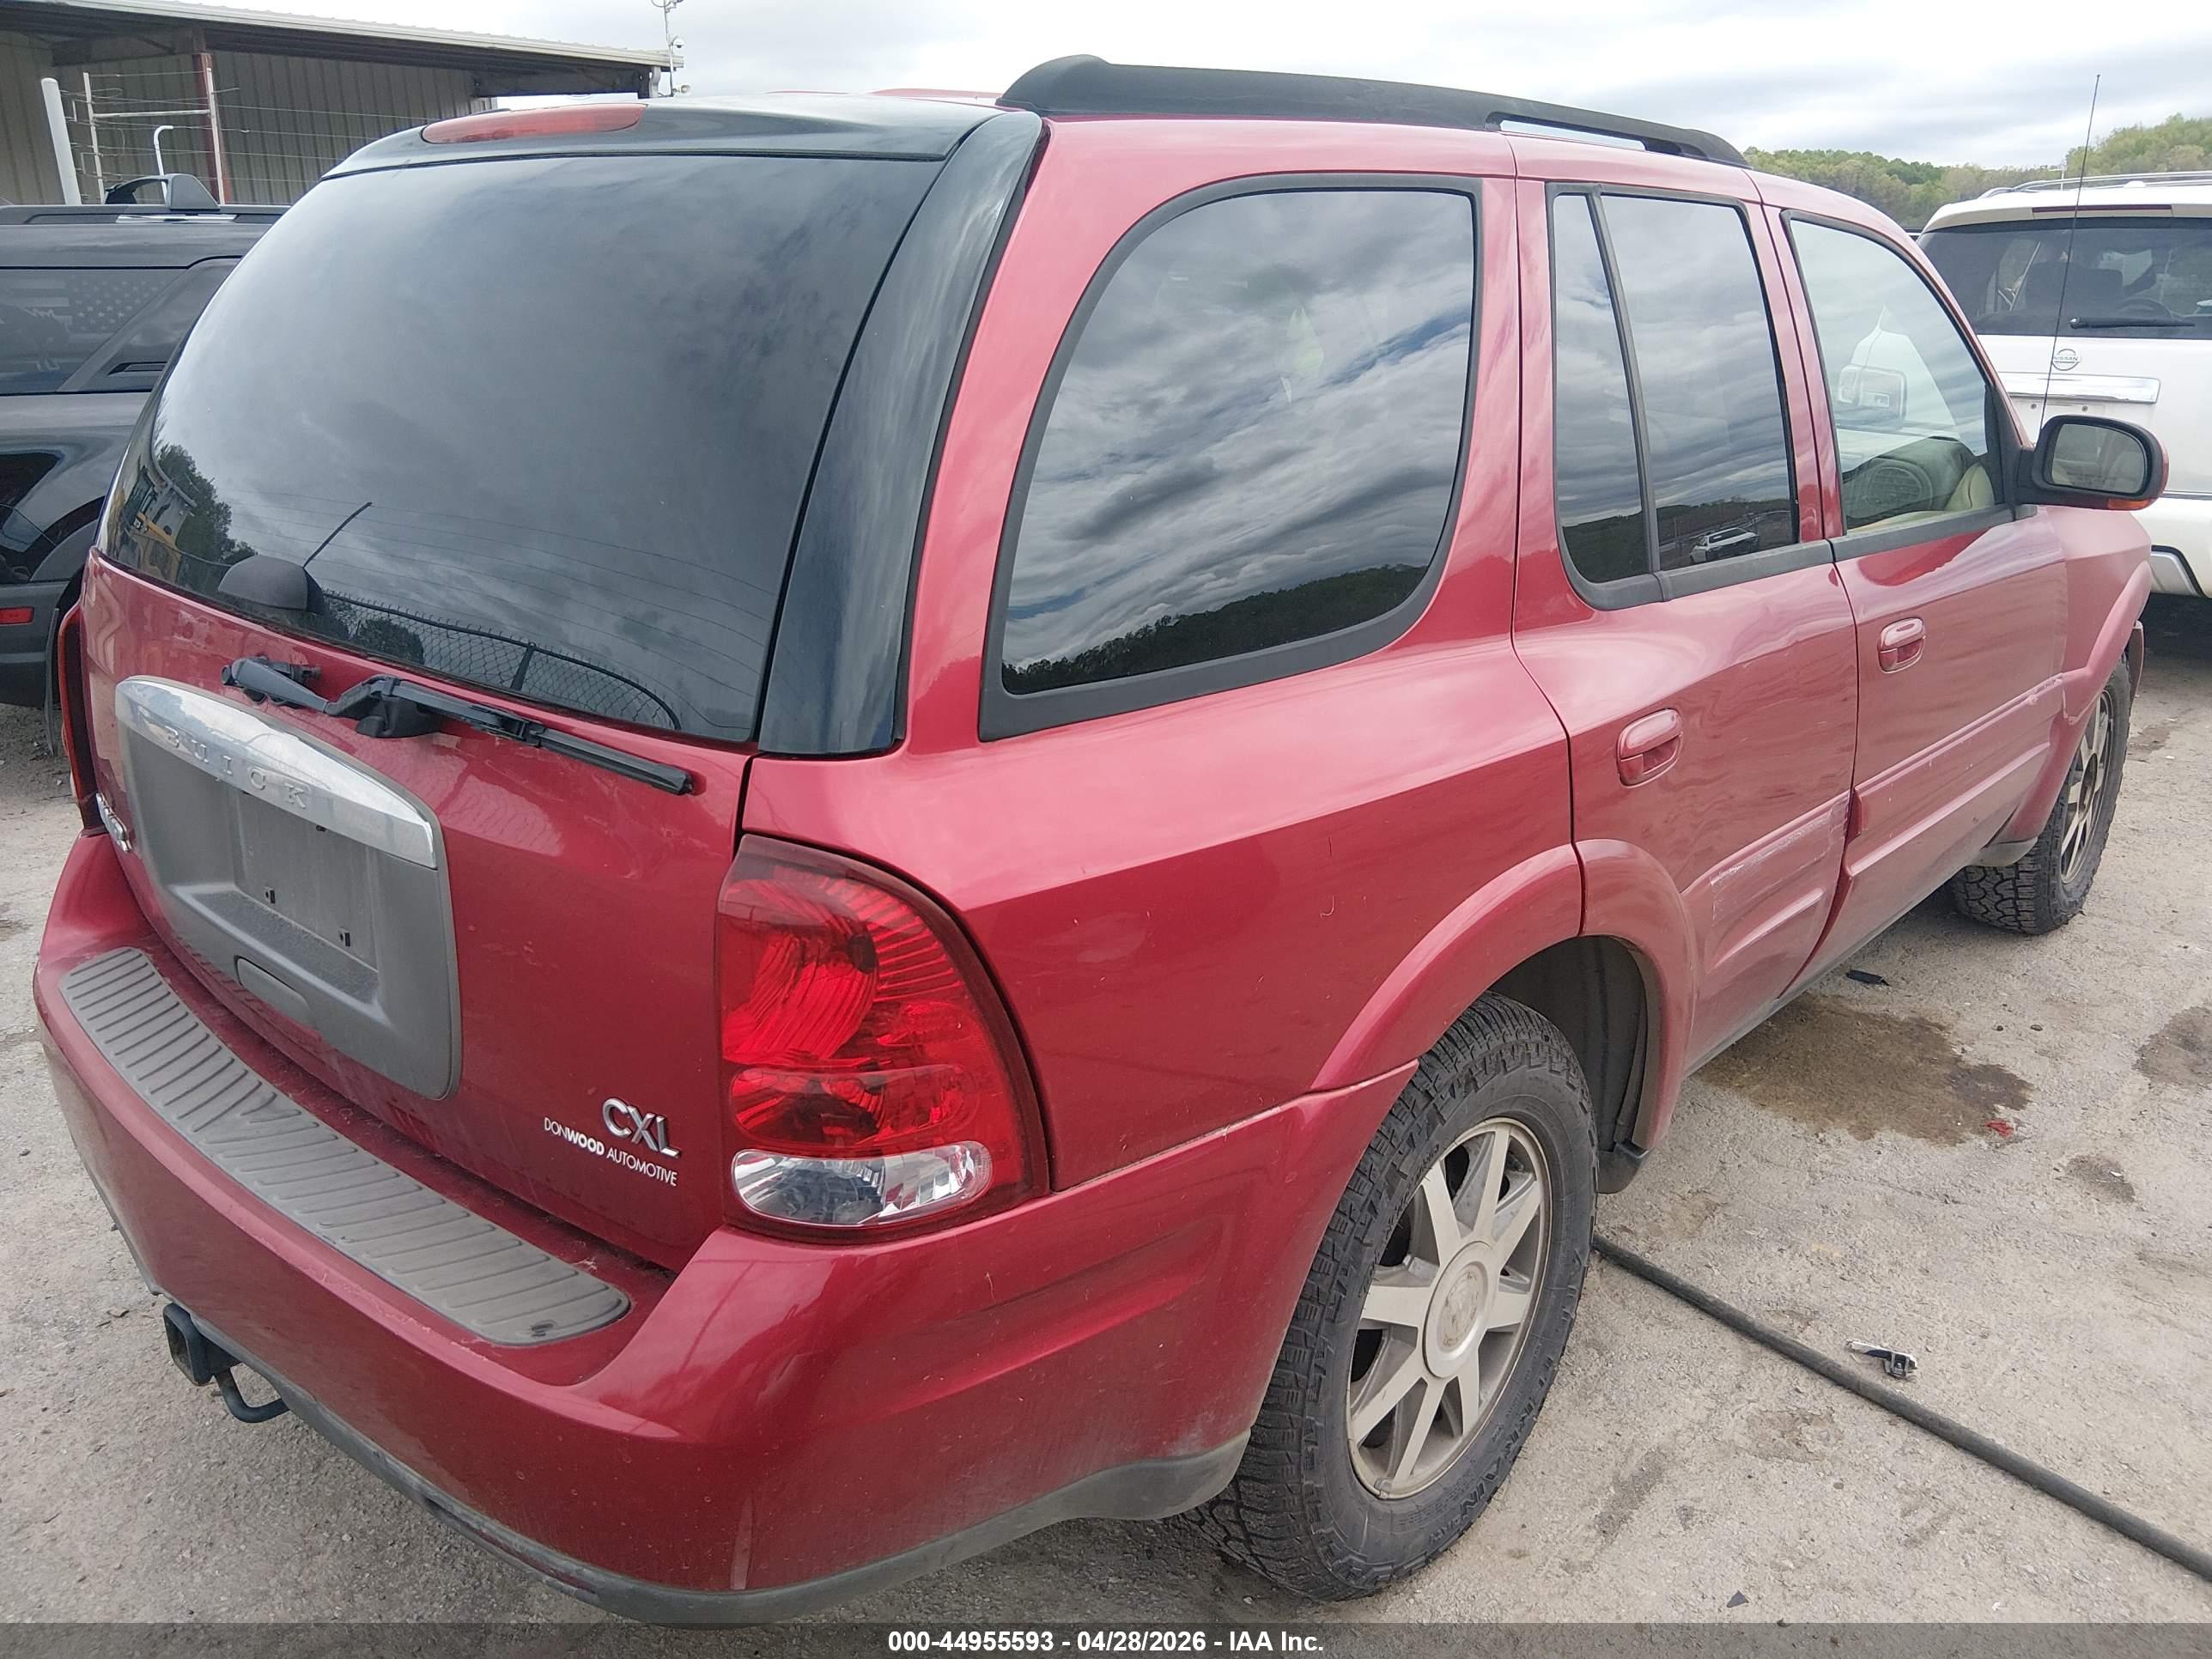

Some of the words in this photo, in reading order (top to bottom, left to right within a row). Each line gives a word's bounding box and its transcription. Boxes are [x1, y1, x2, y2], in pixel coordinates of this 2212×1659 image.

[544, 1117, 605, 1156] DONWOOD
[606, 1146, 678, 1187] AUTOMOTIVE
[603, 1097, 681, 1159] CXL
